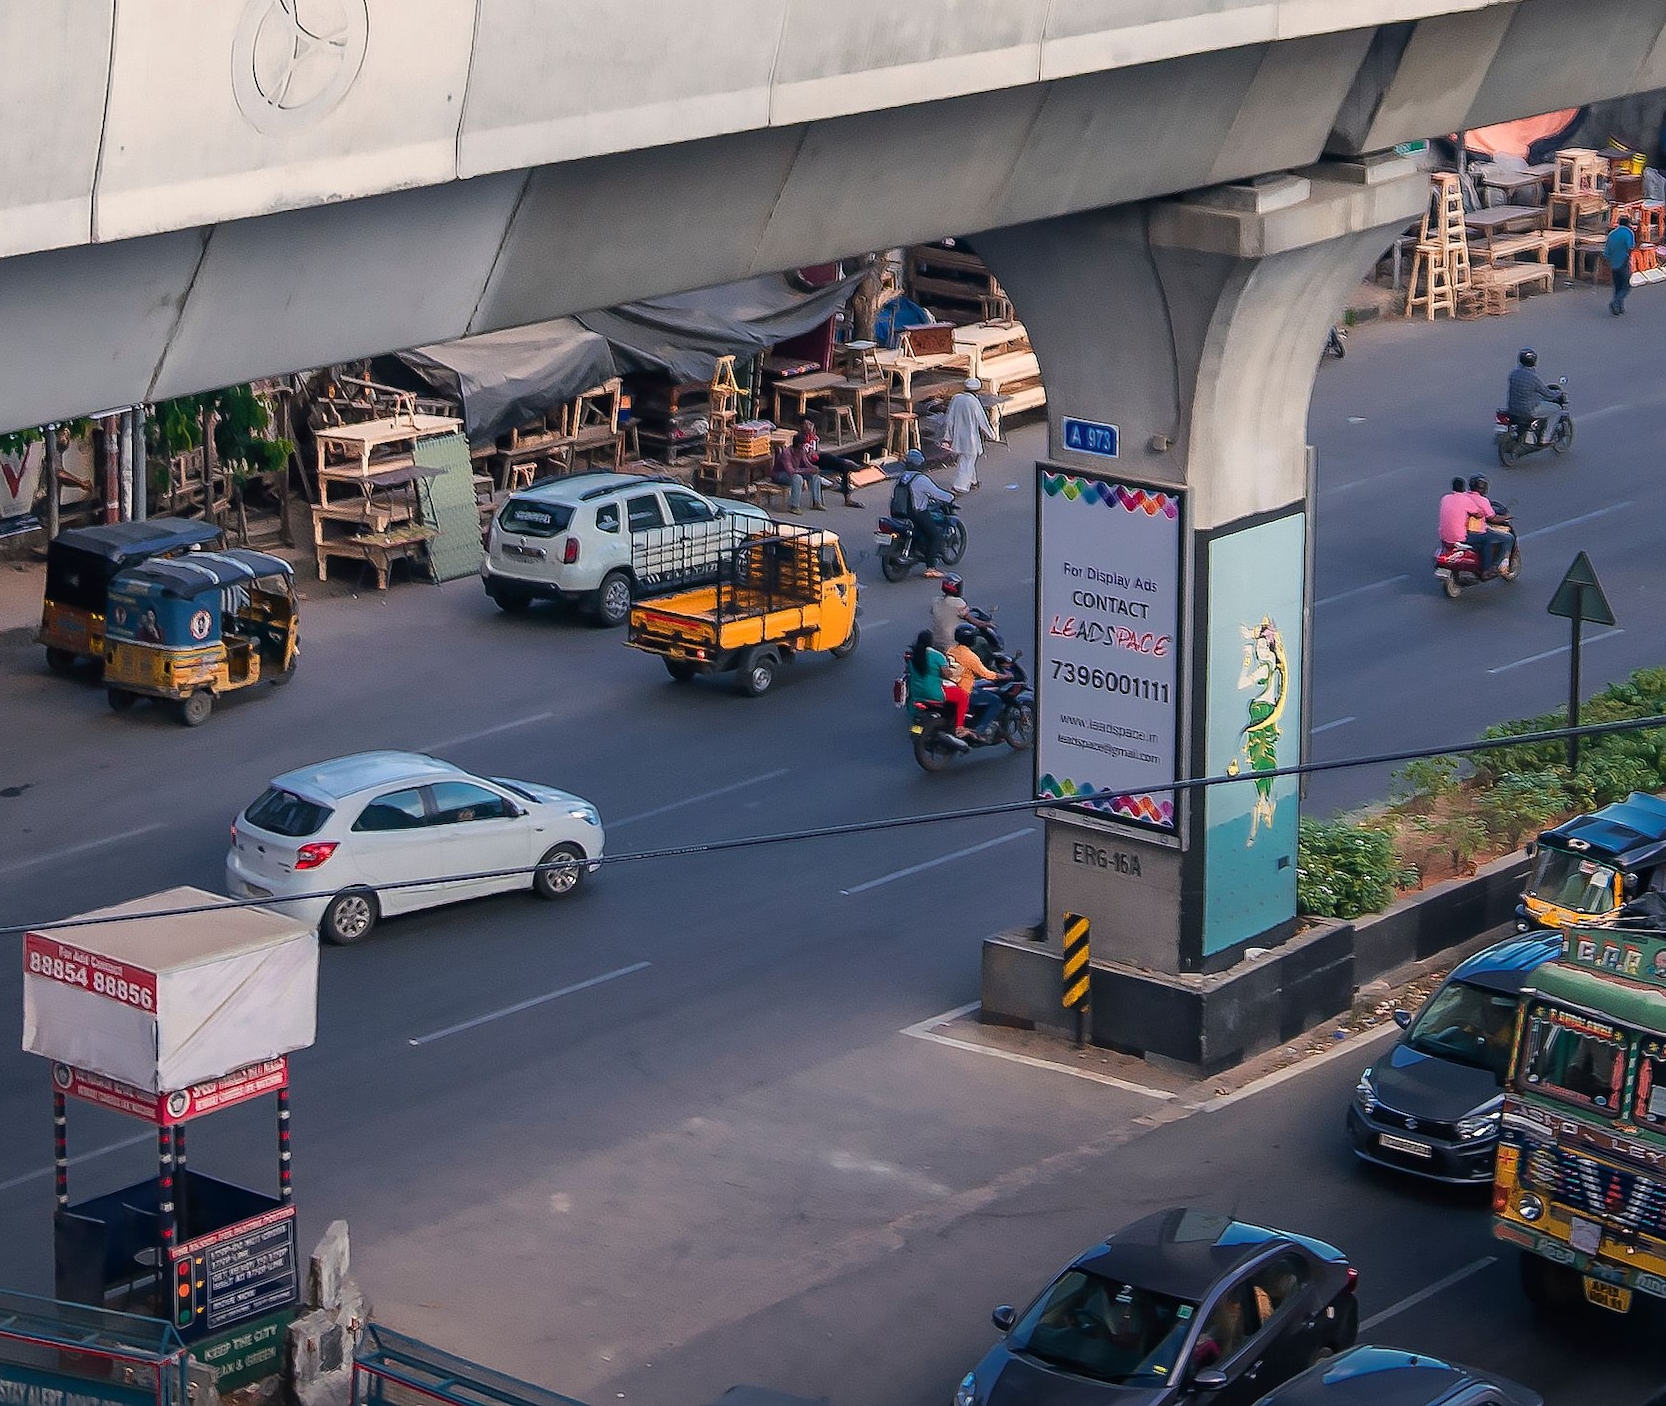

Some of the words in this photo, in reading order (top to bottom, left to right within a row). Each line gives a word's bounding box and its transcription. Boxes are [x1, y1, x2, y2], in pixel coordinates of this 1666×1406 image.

[1069, 424, 1082, 446] A
[1088, 426, 1112, 452] 973
[1063, 561, 1083, 579] For
[1087, 566, 1131, 590] Display
[1134, 576, 1158, 593] Ads
[1072, 590, 1150, 620] CONTACT
[1049, 615, 1172, 656] LEADSPACE
[1051, 659, 1170, 704] 7396001111
